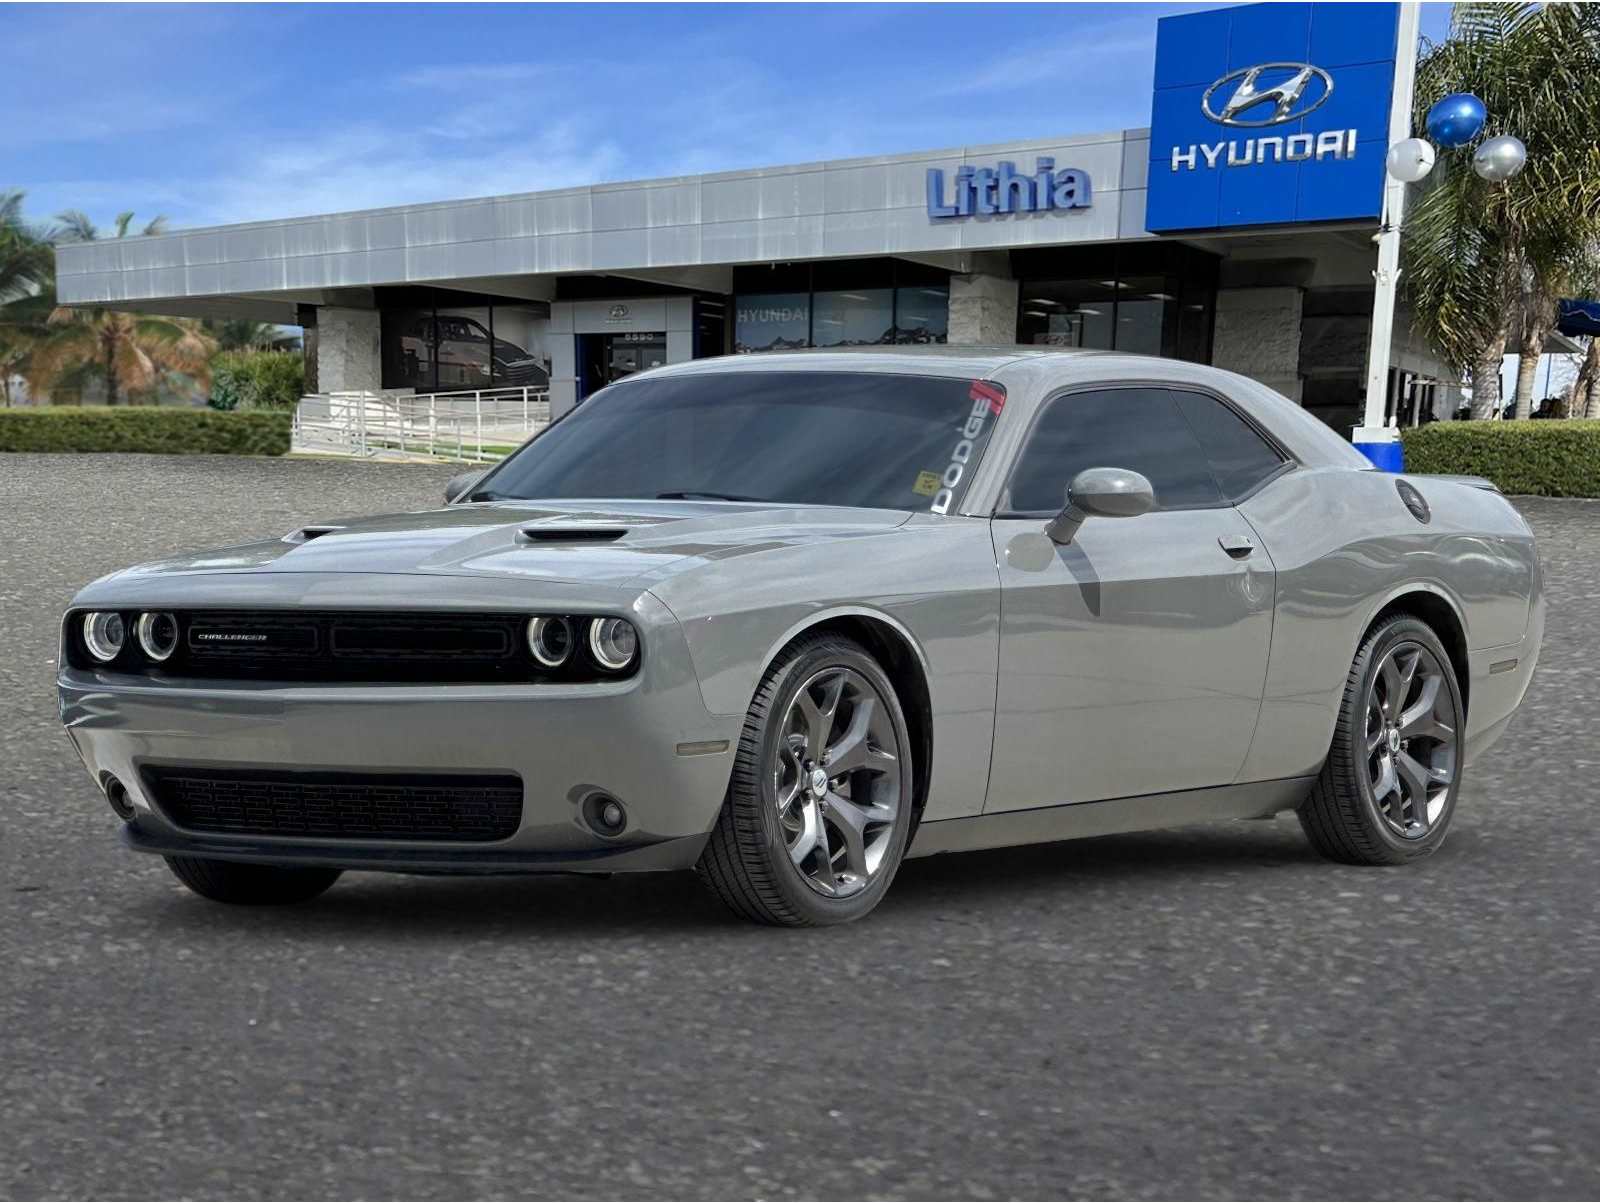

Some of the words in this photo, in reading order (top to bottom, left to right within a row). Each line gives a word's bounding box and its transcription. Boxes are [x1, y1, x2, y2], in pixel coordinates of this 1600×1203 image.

[1170, 128, 1358, 172] HYUNDAI
[926, 156, 1092, 218] Lithia
[737, 306, 809, 324] HYUNDAI
[930, 398, 992, 515] DODGE
